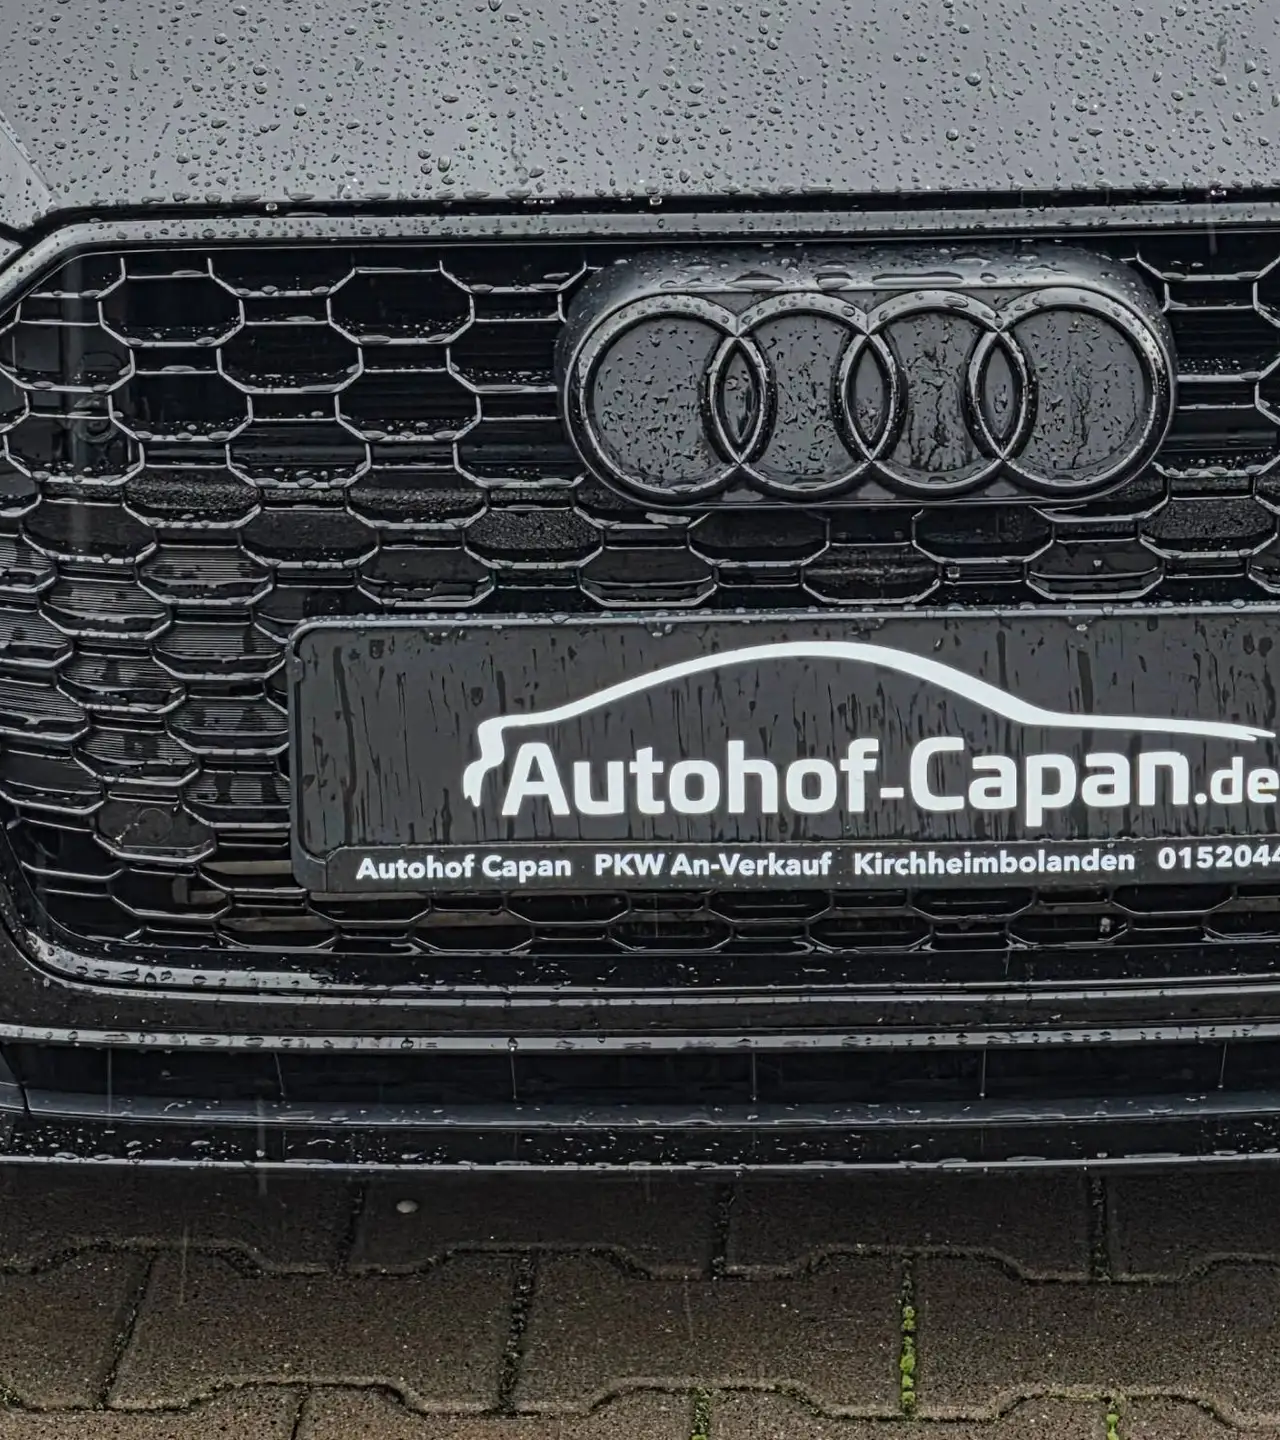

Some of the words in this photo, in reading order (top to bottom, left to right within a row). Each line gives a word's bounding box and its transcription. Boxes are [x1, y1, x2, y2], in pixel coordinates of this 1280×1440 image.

[501, 736, 1280, 828] Autohof-Capan.de
[355, 853, 476, 880] Autohof
[481, 854, 572, 884] Capan
[595, 853, 666, 876] PKW
[670, 851, 833, 877] An-Verkauf
[854, 847, 1135, 876] Kirchheimbolanden
